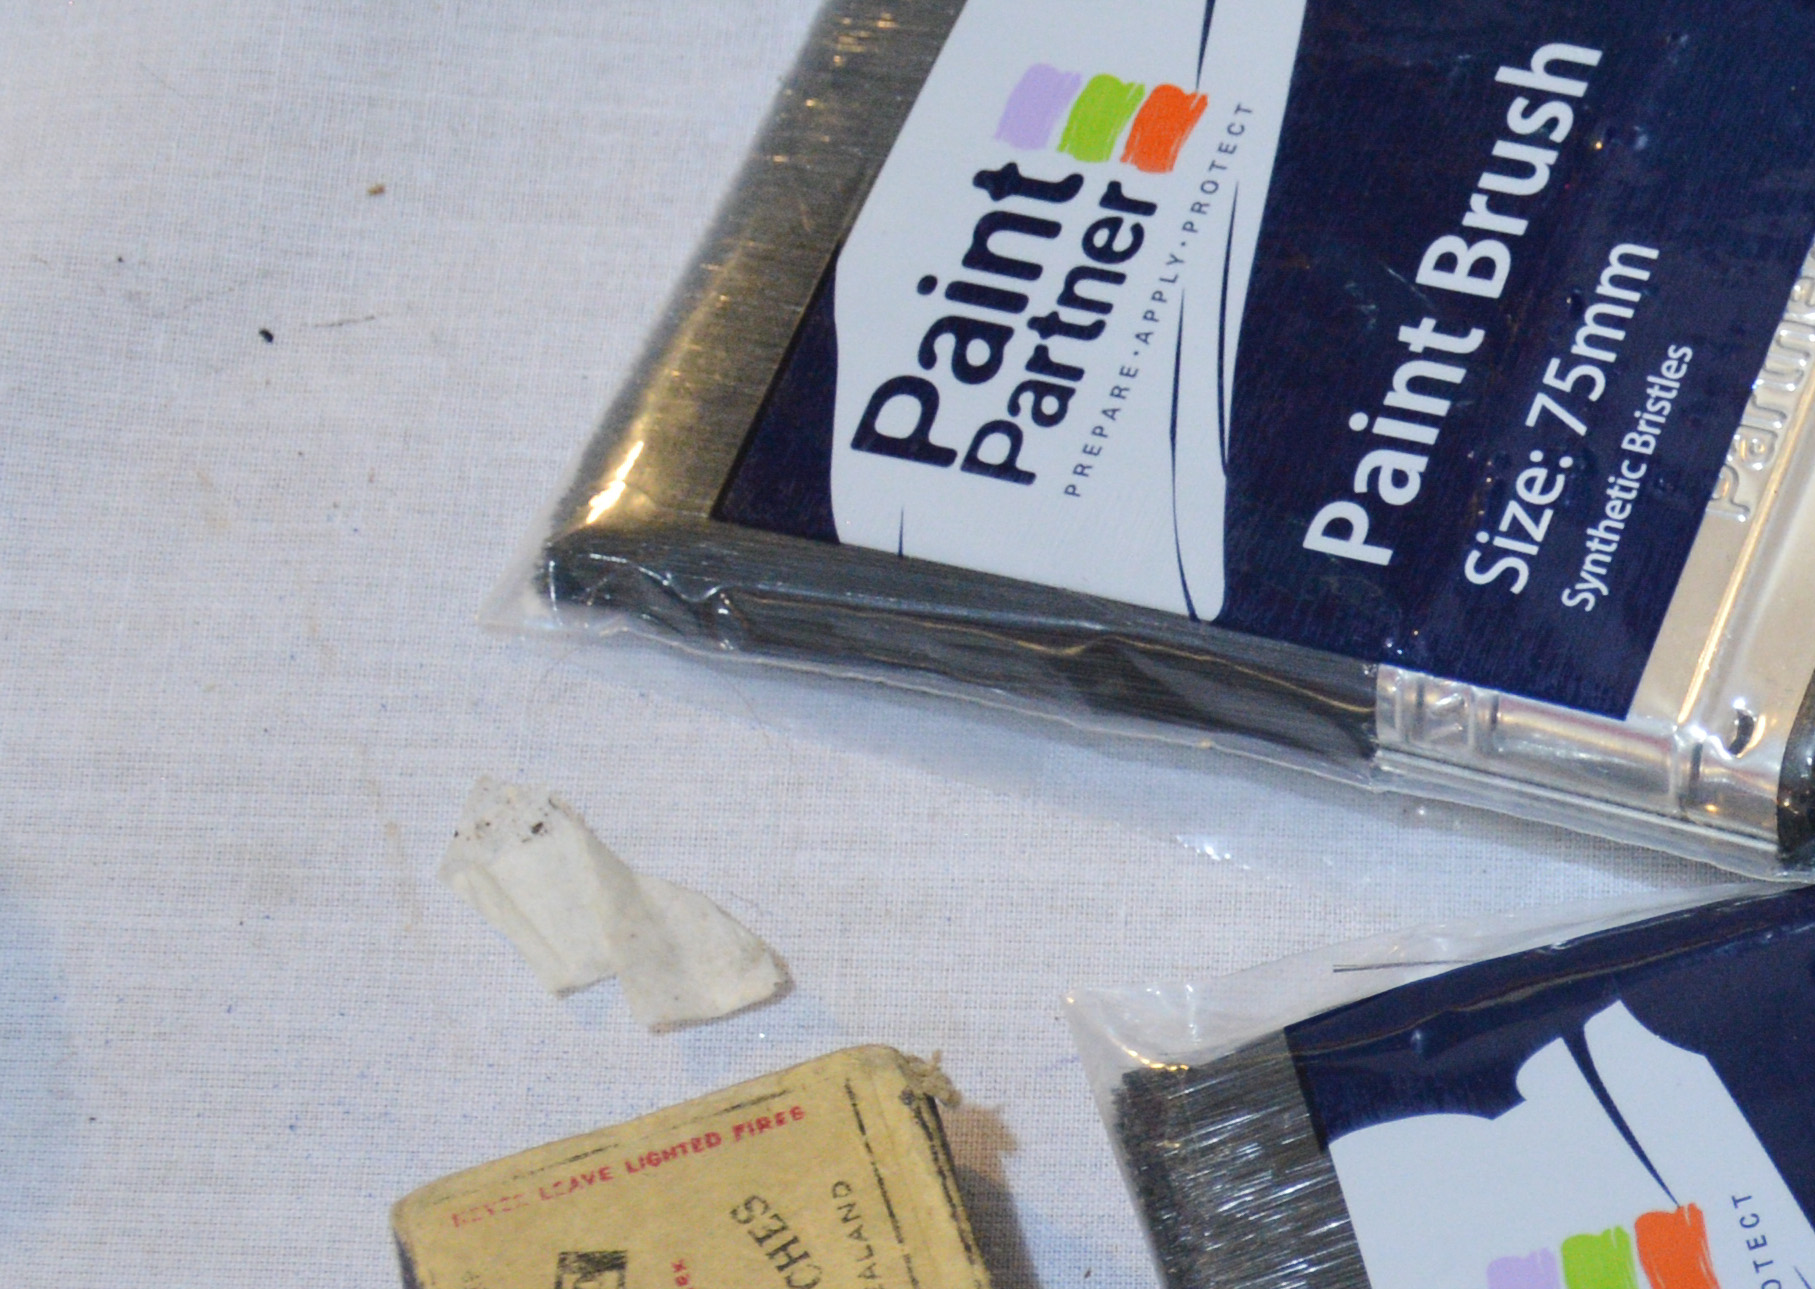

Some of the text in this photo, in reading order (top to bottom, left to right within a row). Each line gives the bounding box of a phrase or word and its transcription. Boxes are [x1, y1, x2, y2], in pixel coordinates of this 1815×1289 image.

[851, 162, 1084, 468] Paint
[960, 180, 1157, 486] Partner
[1303, 42, 1603, 566] Paint Brush
[1463, 242, 1660, 594] Size: 75mm
[1561, 343, 1693, 613] Synthetic Bristles
[625, 1132, 722, 1174] LIGHTED
[732, 1105, 806, 1142] FIRES
